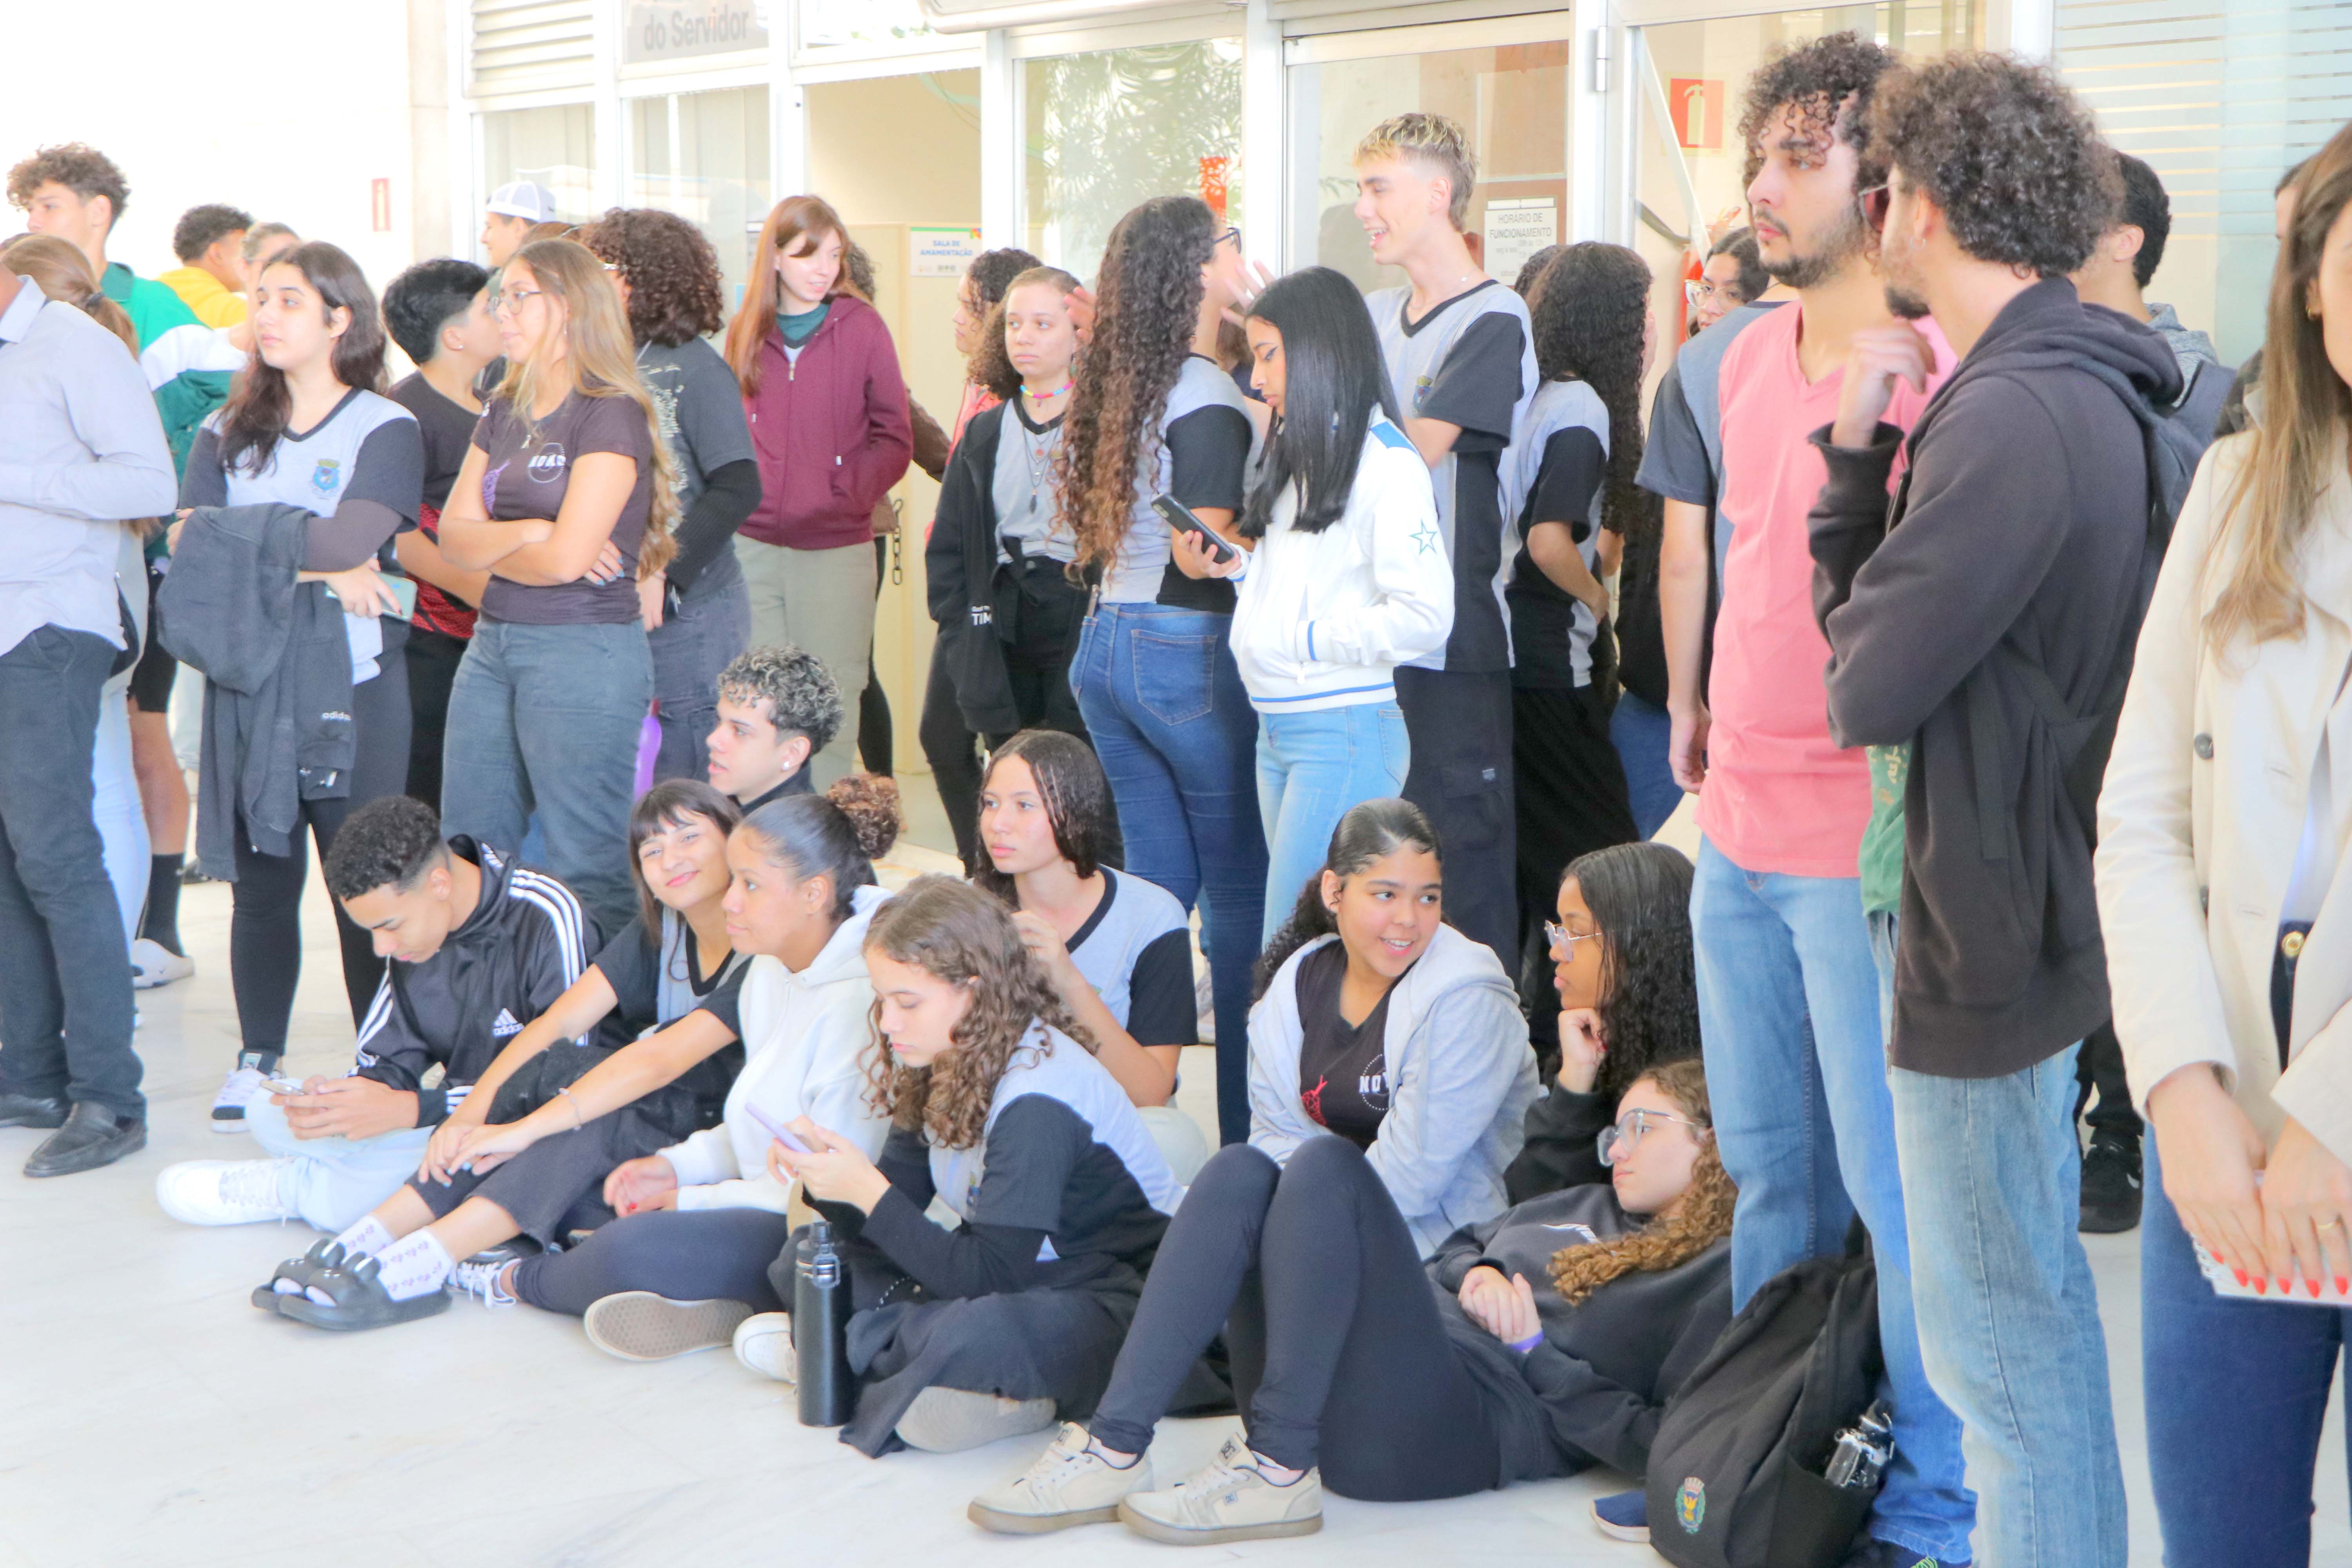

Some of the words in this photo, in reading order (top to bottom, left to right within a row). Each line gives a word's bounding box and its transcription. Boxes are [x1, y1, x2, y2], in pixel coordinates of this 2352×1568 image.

[644, 14, 666, 51] do
[671, 4, 749, 48] Servidor
[1498, 211, 1531, 223] HORÁRIO
[1533, 212, 1543, 222] DE
[1490, 227, 1552, 238] FUNCIONAMENTO
